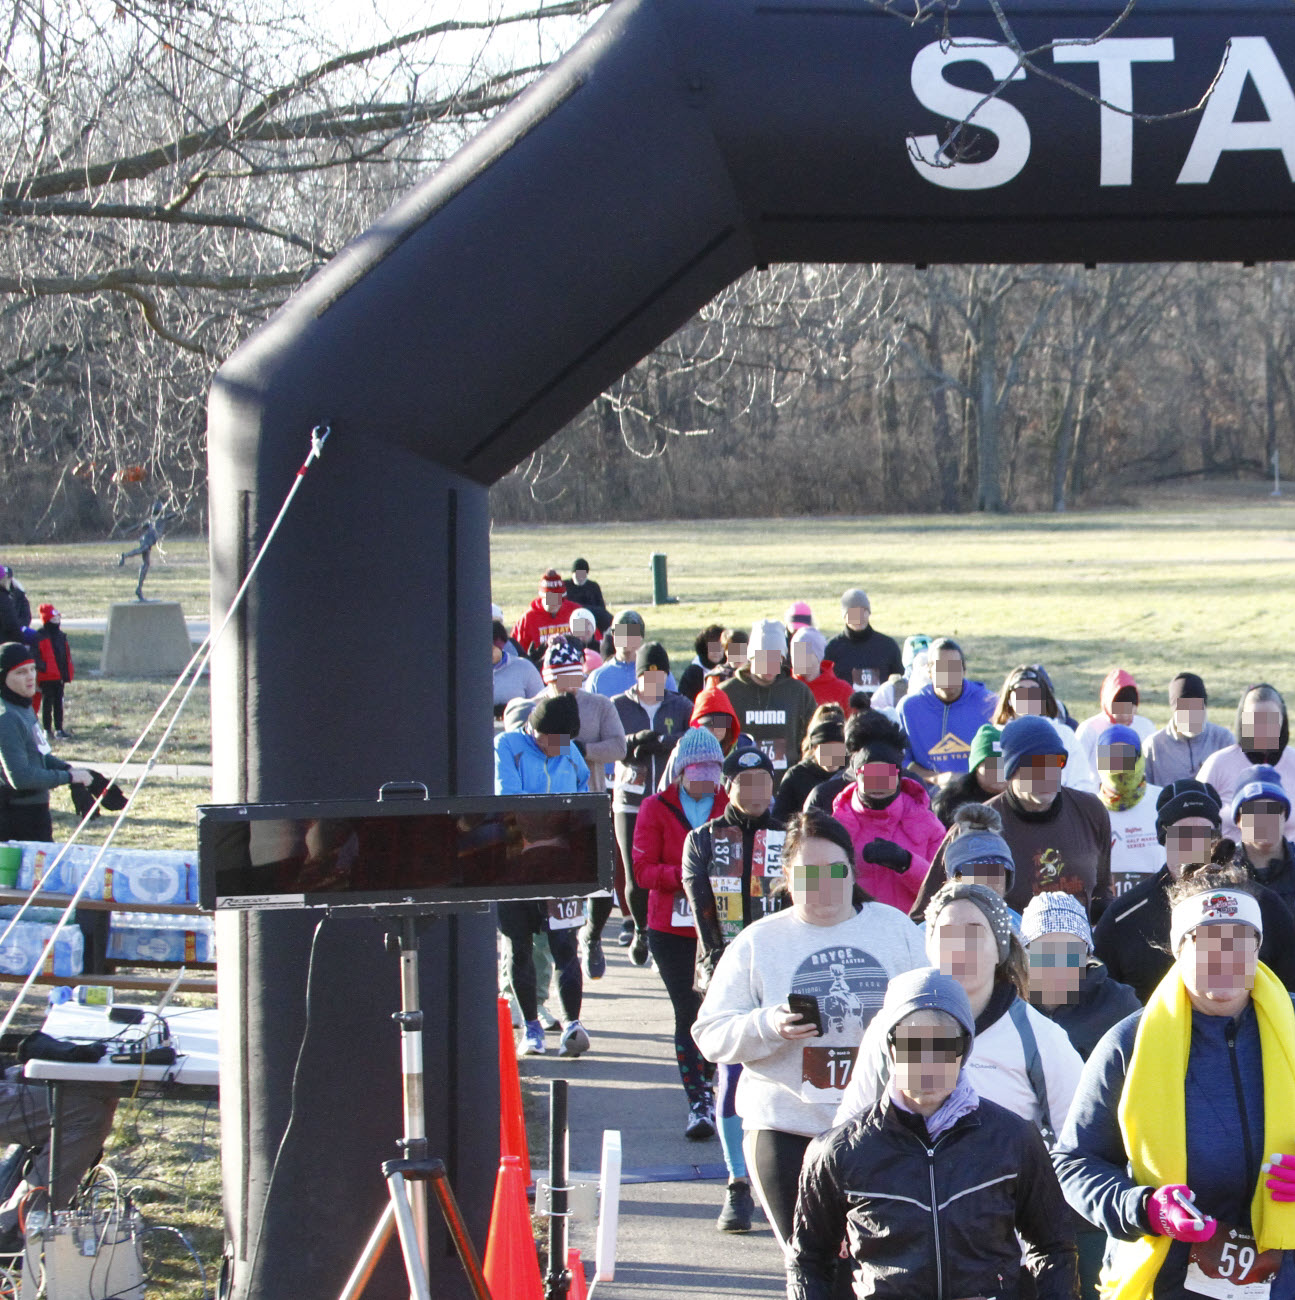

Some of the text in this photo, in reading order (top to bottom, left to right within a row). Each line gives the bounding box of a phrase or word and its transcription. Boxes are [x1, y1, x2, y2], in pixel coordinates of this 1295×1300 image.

[746, 711, 786, 725] PUMA
[715, 837, 730, 865] 137
[767, 844, 784, 875] 354
[557, 901, 578, 919] 167
[811, 948, 854, 966] BRYCE
[826, 1060, 852, 1086] 17
[1217, 1242, 1255, 1281] 59
